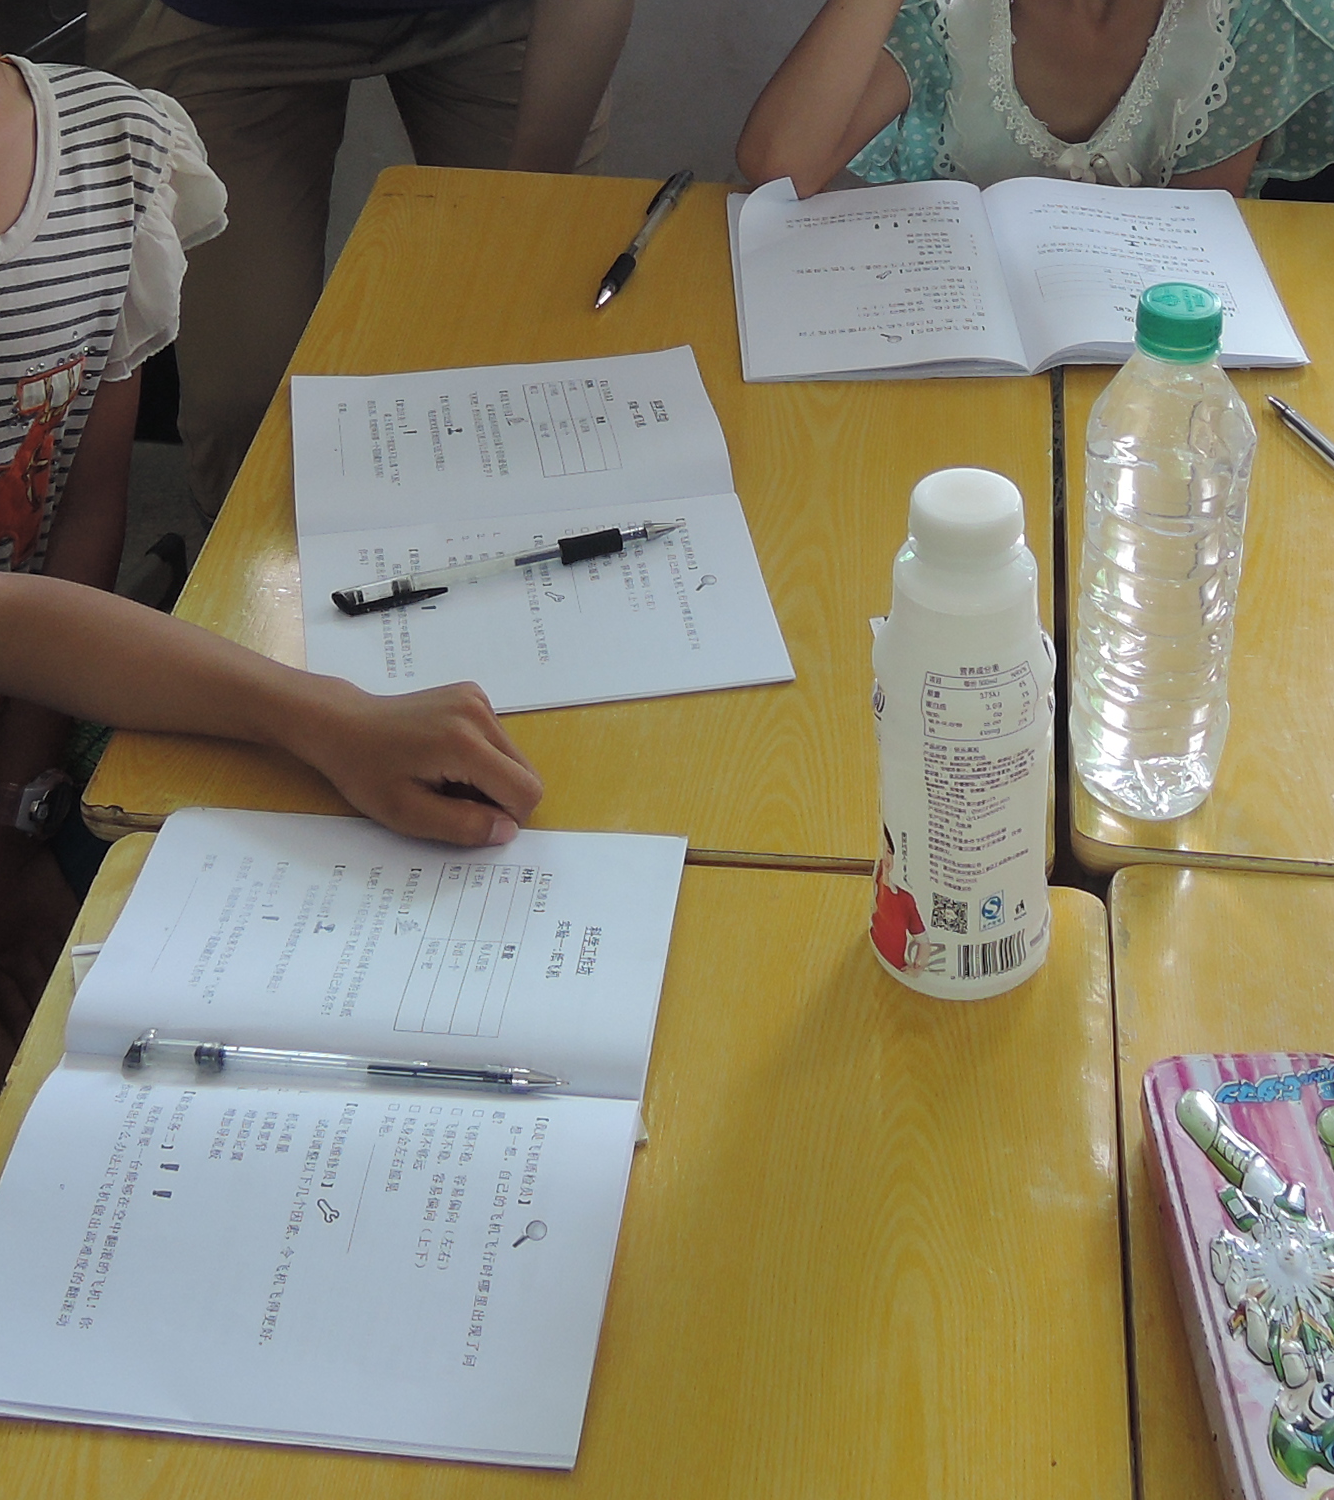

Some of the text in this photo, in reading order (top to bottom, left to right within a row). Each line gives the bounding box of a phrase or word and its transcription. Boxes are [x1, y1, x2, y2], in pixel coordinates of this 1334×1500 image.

[575, 926, 602, 976] 科学工作坊
